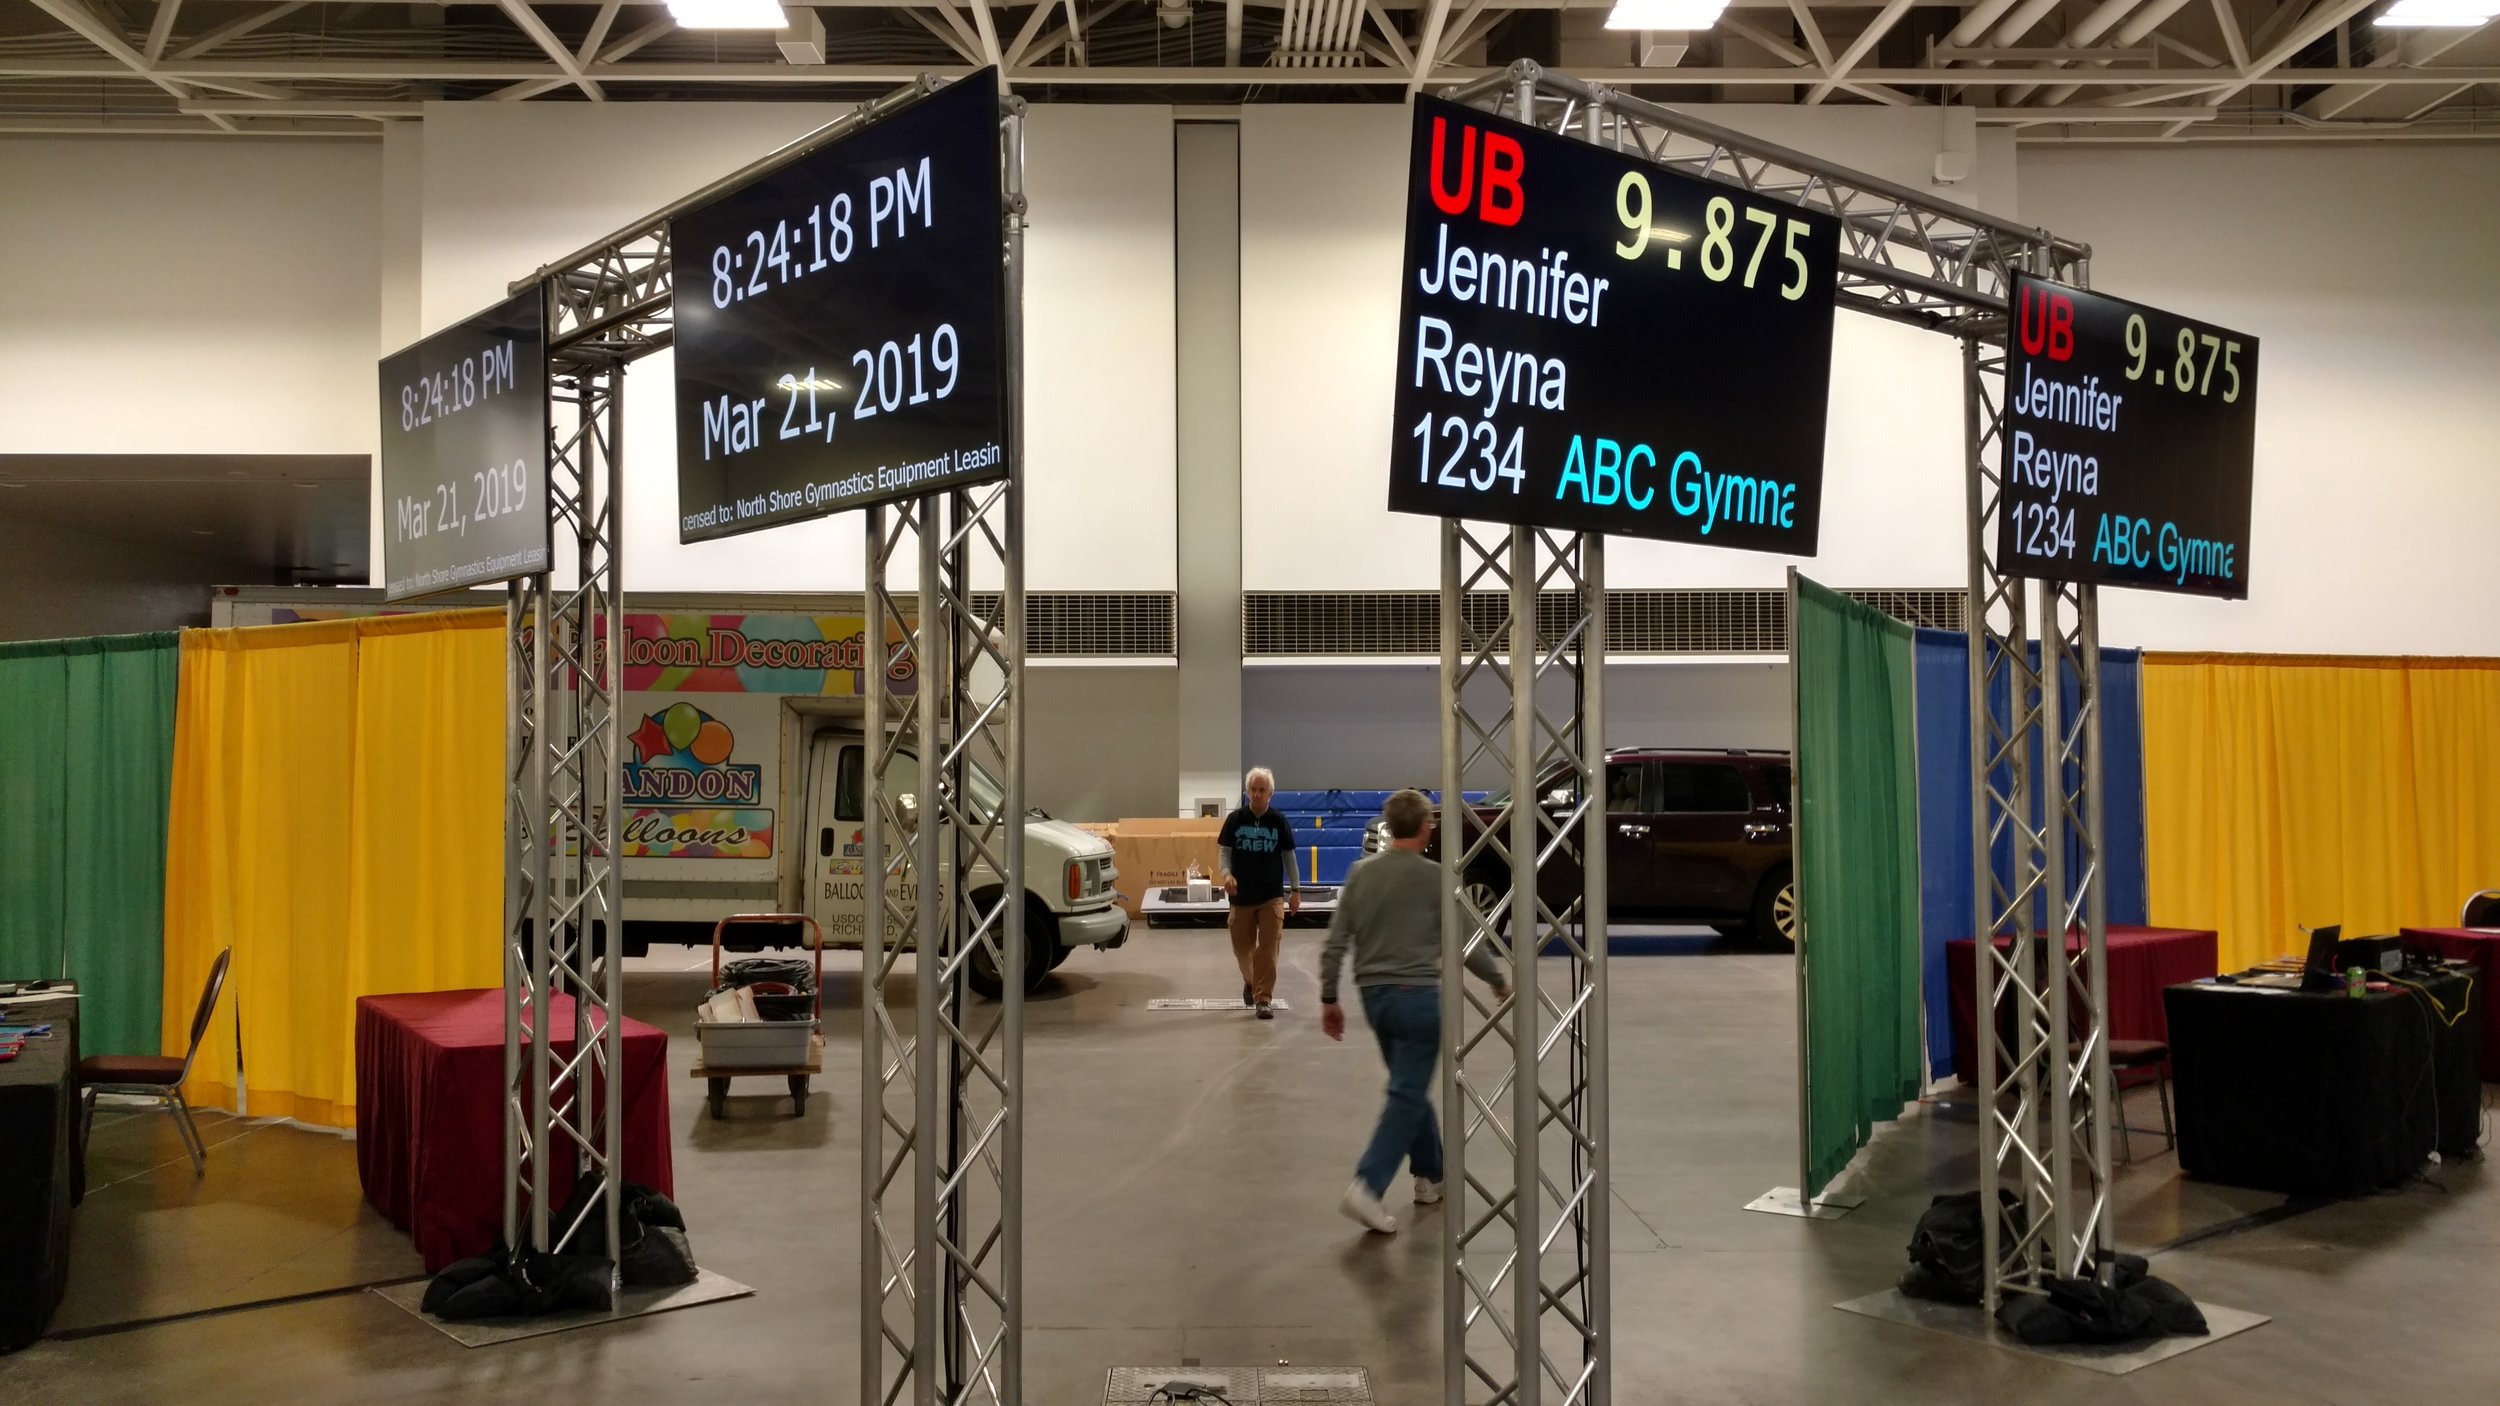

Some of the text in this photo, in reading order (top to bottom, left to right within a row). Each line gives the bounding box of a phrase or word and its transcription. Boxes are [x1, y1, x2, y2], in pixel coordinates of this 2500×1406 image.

[712, 155, 933, 310] 8:24:18 PM
[1429, 116, 1811, 301] UB 9.875
[1419, 222, 1610, 328] Jennifer
[401, 339, 515, 433] 8:24:18 PM
[1414, 315, 1567, 419] Reyna
[2020, 283, 2241, 404] UB 9.875
[703, 323, 960, 461] Mar 21, 2019
[2014, 361, 2123, 433] Jennifer
[397, 458, 527, 543] Mar 21, 2019
[682, 441, 1001, 532] censed to: North Shore Gymnastics Equipment Leasin
[1413, 411, 1527, 495] 1234
[1555, 433, 1657, 510] ABC
[2012, 430, 2099, 504] Reyna
[2012, 500, 2077, 560] 1234
[2092, 512, 2151, 569] ABC
[707, 628, 916, 680] Decoratig
